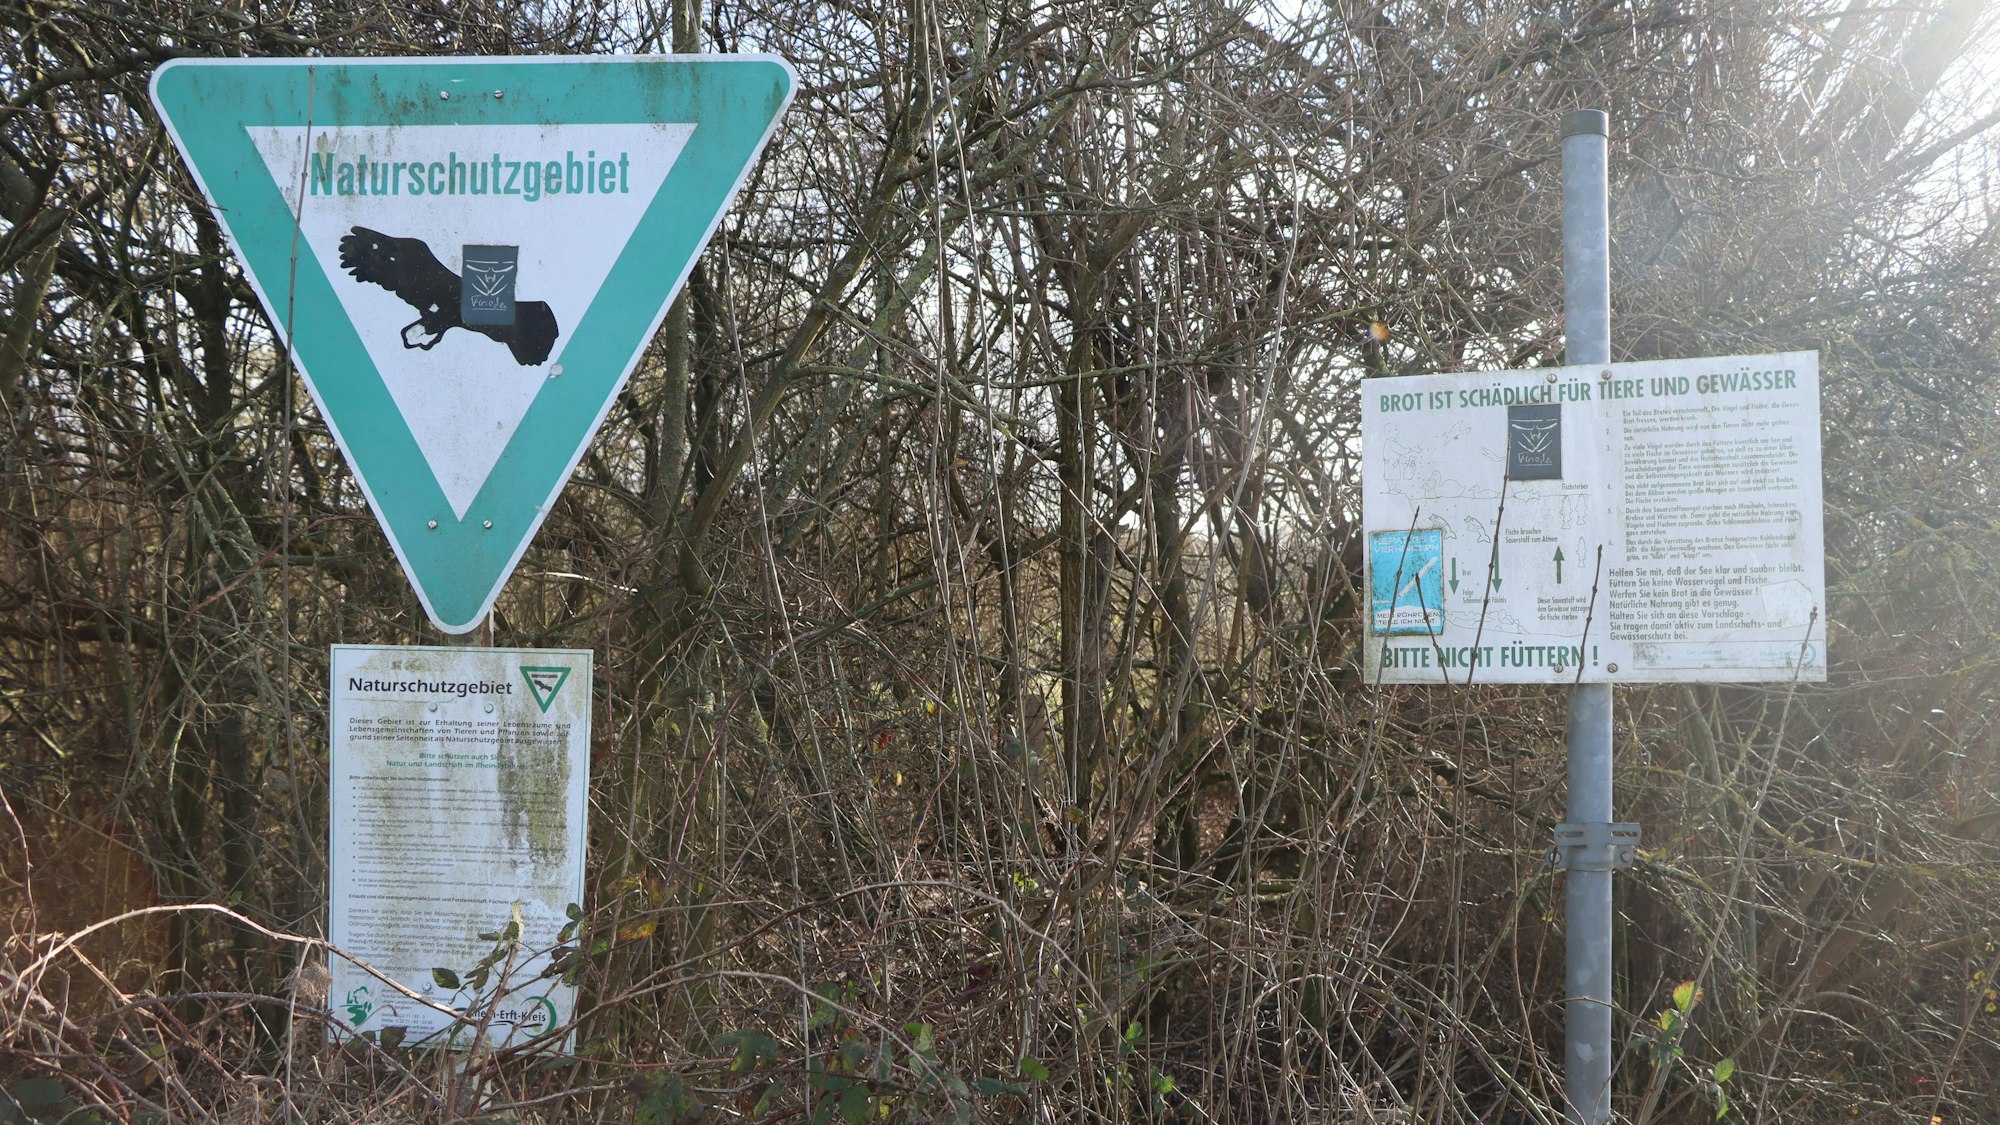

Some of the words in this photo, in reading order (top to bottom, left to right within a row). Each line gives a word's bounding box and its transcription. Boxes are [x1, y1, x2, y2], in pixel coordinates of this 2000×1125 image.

[310, 150, 630, 202] Naturschutzgebiet
[1380, 392, 1424, 412] BROT
[1429, 390, 1453, 410] IST
[1459, 382, 1550, 408] SCHÄDLICH
[1558, 378, 1592, 402] FÜR
[1598, 378, 1644, 400] TIERE
[1650, 376, 1690, 397] UND
[1696, 367, 1796, 394] GEWÄSSER
[1609, 568, 1633, 577] Helfen
[1635, 568, 1647, 576] Sie
[1649, 567, 1664, 577] mit,
[1666, 567, 1681, 576] daß
[1683, 567, 1696, 575] der
[1698, 566, 1712, 575] See
[1714, 566, 1730, 574] klar
[1732, 565, 1747, 574] und
[1749, 565, 1776, 574] sauber
[1778, 564, 1804, 573] bleibt.
[1609, 579, 1636, 588] Füttern
[1638, 578, 1650, 587] Sie
[1651, 578, 1672, 586] keine
[1674, 577, 1725, 588] Wasservögel
[1727, 576, 1742, 585] und
[1609, 590, 1636, 598] Werfen
[1639, 589, 1651, 598] Sie
[1652, 589, 1669, 598] kein
[1671, 588, 1688, 597] Brot
[1690, 588, 1698, 597] in
[1699, 588, 1711, 597] die
[1713, 587, 1752, 596] Gewässer
[1609, 600, 1647, 608] Natürliche
[1649, 599, 1682, 610] Nahrung
[1684, 599, 1699, 609] gibt
[1712, 600, 1739, 609] genug.
[1609, 611, 1634, 620] Halten
[1636, 611, 1648, 619] Sie
[1650, 611, 1664, 619] sich
[1678, 610, 1698, 619] diese
[1701, 609, 1744, 620] Vorschläge
[1609, 622, 1621, 631] Sie
[1623, 622, 1648, 632] tragen
[1650, 621, 1672, 630] damit
[1674, 621, 1694, 630] aktiv
[1715, 620, 1765, 629] Landschafts-
[1766, 619, 1782, 628] und
[1609, 632, 1671, 640] Gewässerschutz
[1673, 631, 1688, 640] bei.
[1382, 648, 1430, 668] BITTE
[1438, 646, 1494, 668] NICHT
[1501, 640, 1584, 668] FÜTTERN
[1593, 646, 1598, 666] !
[349, 678, 512, 698] Naturschutzgebiet
[435, 719, 472, 728] Erhaltung
[349, 726, 434, 735] Lebensgemeinschaften
[349, 734, 372, 742] grund
[445, 736, 513, 745] Naturschutzgebiet
